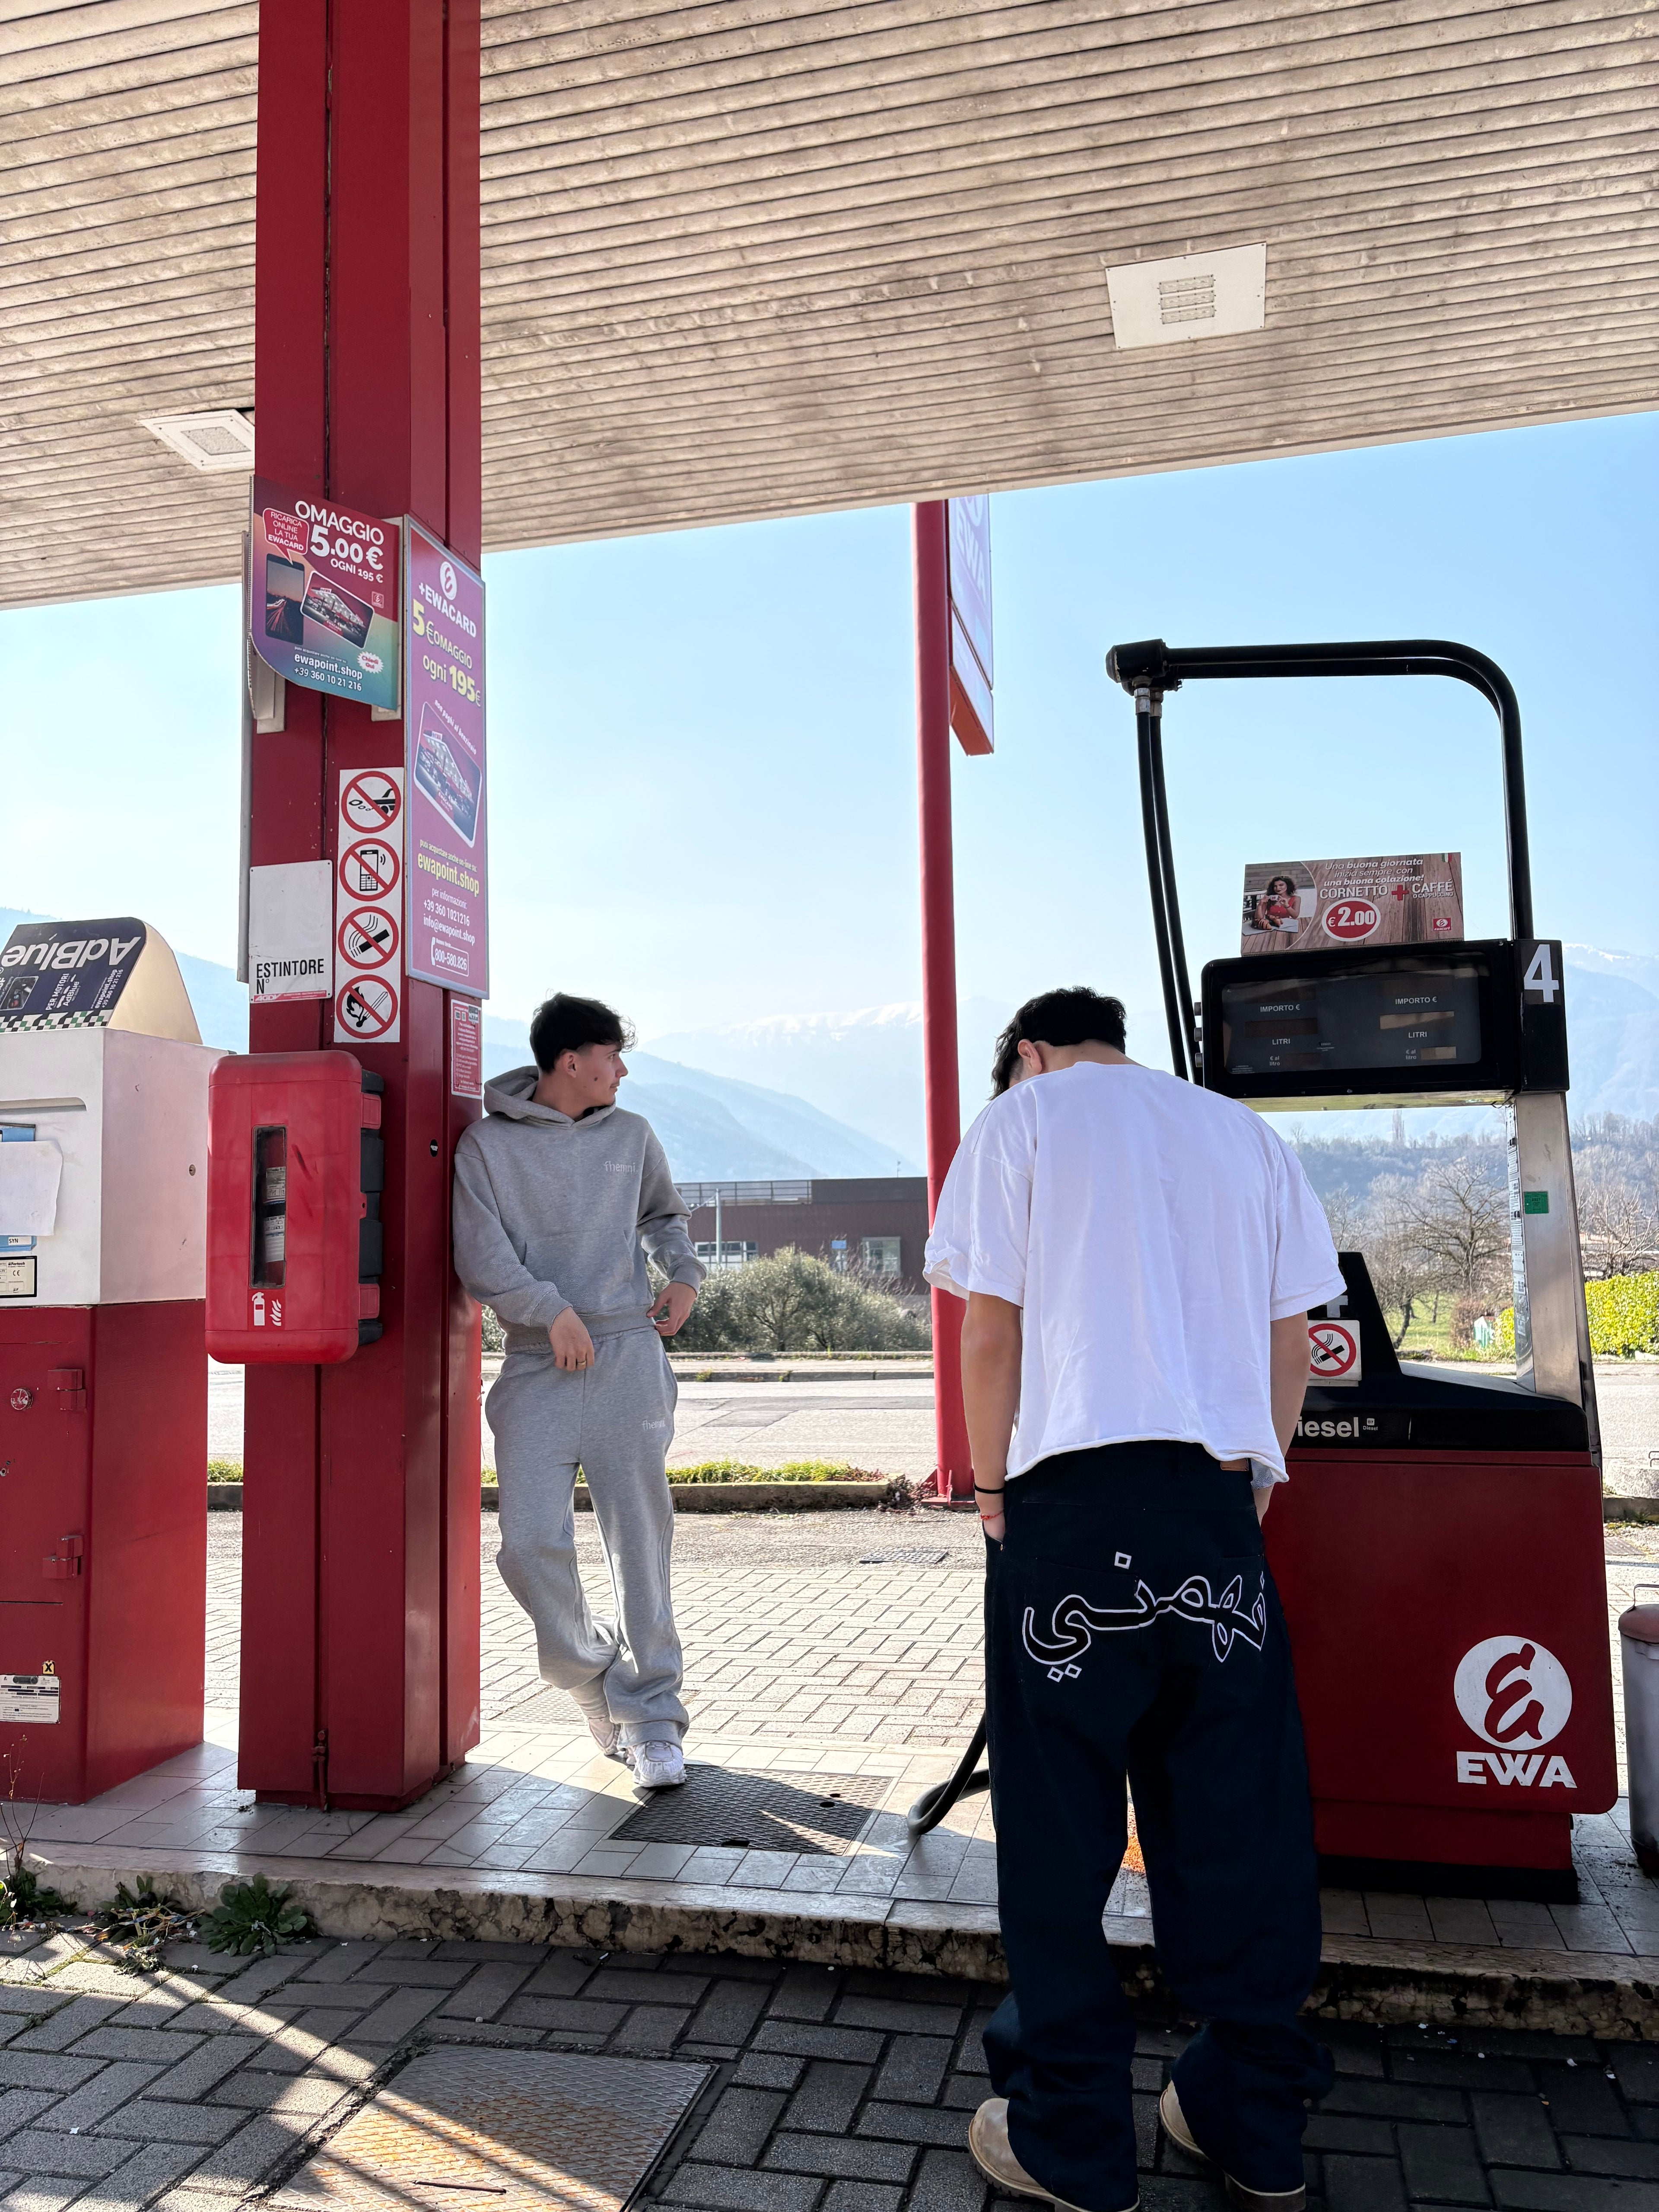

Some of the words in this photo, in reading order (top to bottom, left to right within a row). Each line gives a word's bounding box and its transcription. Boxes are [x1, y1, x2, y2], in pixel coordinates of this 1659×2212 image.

[270, 511, 302, 528] RICARICA
[273, 520, 298, 534] ONLINE
[295, 501, 384, 545] OMAGGIO
[268, 534, 304, 551] EWACARD
[274, 528, 283, 537] LA
[284, 531, 298, 541] TUA
[331, 558, 356, 574] OGNI
[434, 632, 472, 669] OMAGGIO
[294, 654, 362, 681] ewapoint.shop
[423, 655, 447, 683] ogni
[294, 667, 309, 677] +39
[310, 670, 325, 681] 360
[327, 674, 336, 684] 10
[337, 677, 346, 687] 21
[348, 681, 362, 691] 216
[442, 710, 454, 727] paghi
[1359, 868, 1392, 877] sempre
[1380, 858, 1424, 869] giornata
[418, 853, 480, 897] ewapoint.shop
[1375, 874, 1425, 884] colazione!
[440, 889, 467, 909] informazioni:
[1319, 885, 1388, 899] CORNETTO
[424, 899, 434, 912] +39
[435, 903, 445, 917] 360
[447, 907, 470, 926] 1021216
[1338, 906, 1375, 926] 2.00
[423, 914, 475, 946] info@ewapoint.shop
[1, 936, 141, 971] AdBlue
[256, 958, 324, 979] ESTINTORE
[1523, 944, 1559, 1002] 4
[45, 998, 57, 1010] PER
[52, 973, 70, 997] MOTORI
[63, 981, 79, 1006] AdBlue
[95, 969, 118, 1009] ewapoint.shop
[1297, 1416, 1359, 1437] iesel
[44, 1663, 52, 1672] X
[1456, 1751, 1577, 1788] EWA
